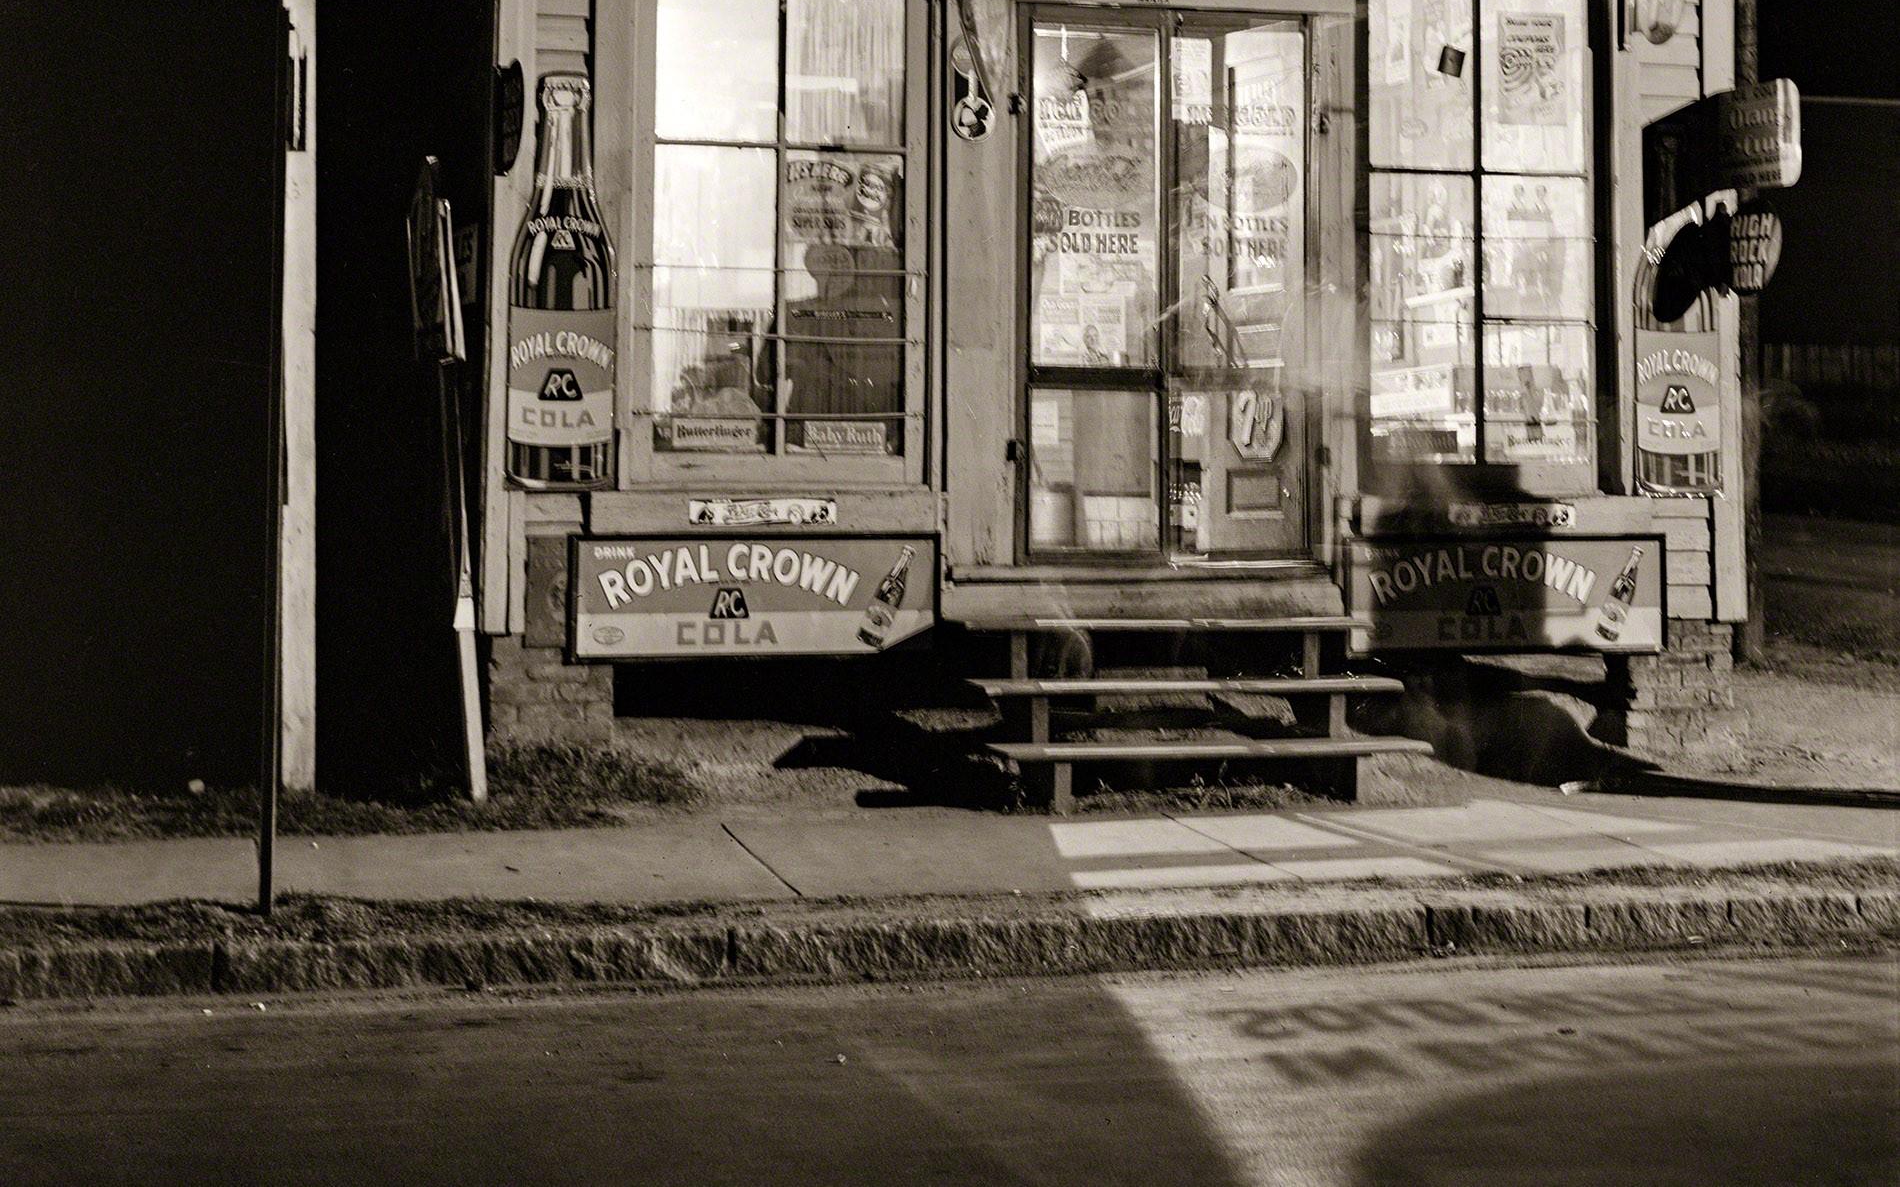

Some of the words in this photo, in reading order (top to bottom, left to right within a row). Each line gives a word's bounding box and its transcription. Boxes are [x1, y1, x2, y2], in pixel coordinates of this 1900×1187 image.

[1068, 209, 1141, 228] BOTTLES
[1731, 212, 1774, 239] HIGH
[1046, 232, 1092, 253] SOLD
[1095, 232, 1139, 254] HERE
[1731, 238, 1769, 265] ROCK
[511, 332, 555, 372] ROYAL
[555, 330, 614, 370] CROWN
[1636, 349, 1671, 387] ROYAL
[1672, 349, 1719, 388] CROWN
[544, 373, 578, 399] RC
[1663, 387, 1691, 411] RC
[521, 406, 596, 429] COLA
[1647, 417, 1706, 440] COLA
[676, 424, 752, 440] Butterfinger
[846, 426, 883, 445] Ruth
[593, 545, 636, 561] DRINK
[598, 543, 720, 610] ROYAL
[726, 543, 861, 607] CROWN
[1368, 546, 1475, 607] ROYAL
[1481, 545, 1598, 605] CROWN
[713, 590, 747, 619] RC
[676, 620, 779, 645] COLA
